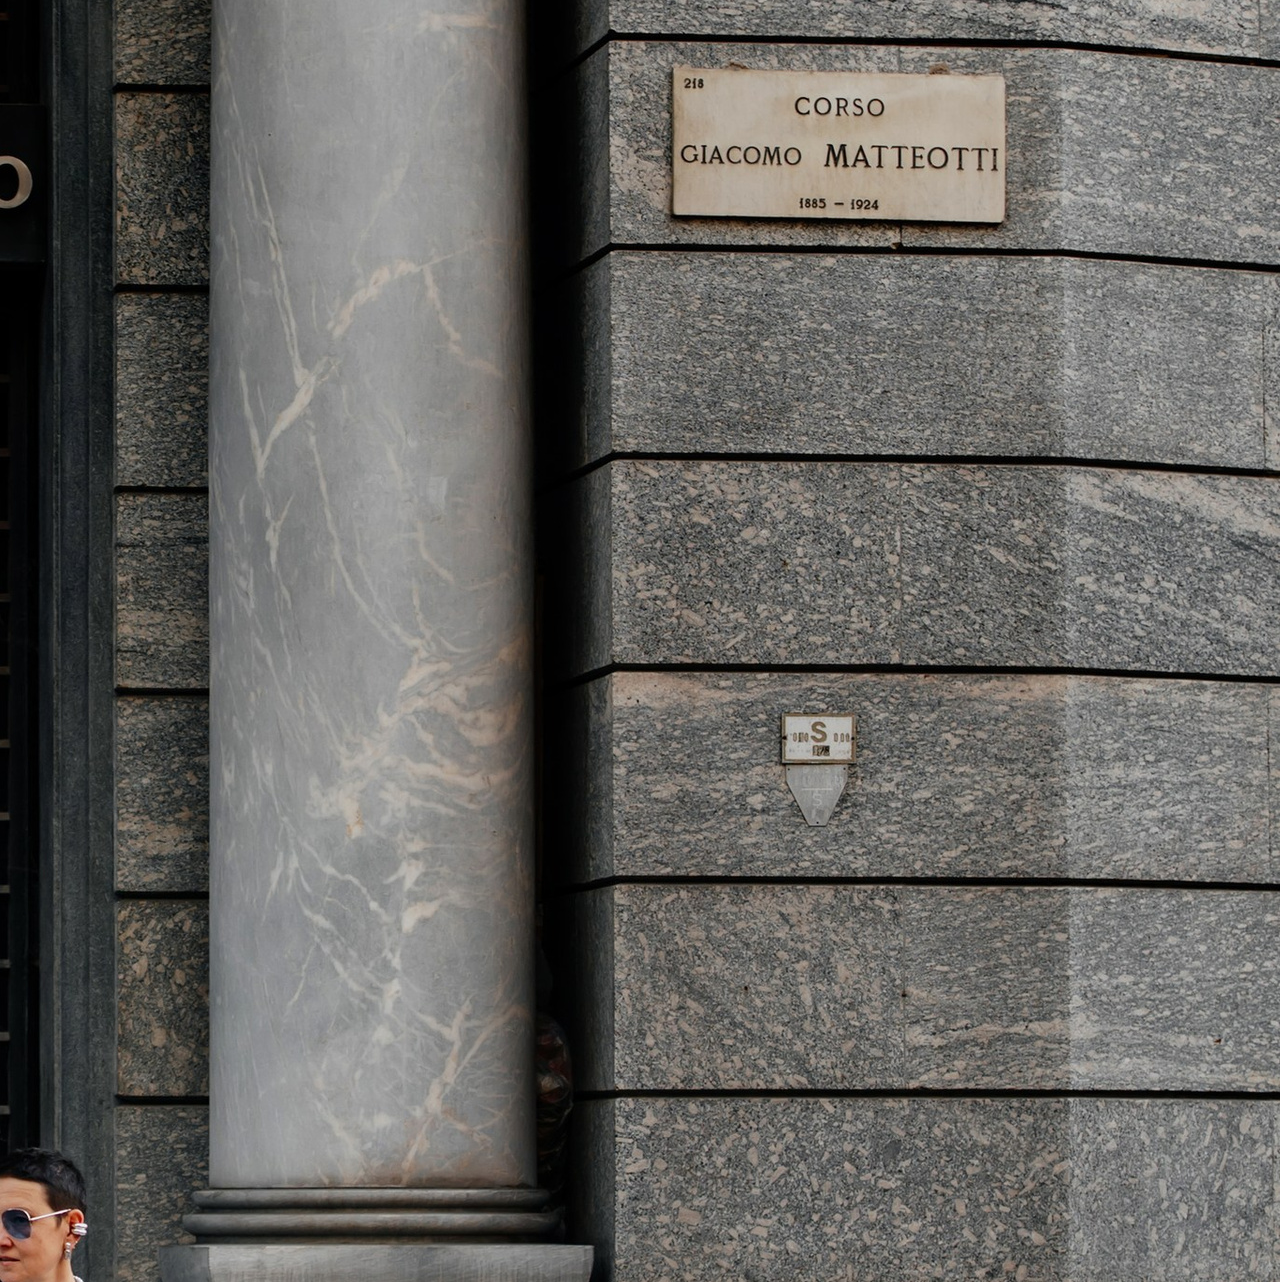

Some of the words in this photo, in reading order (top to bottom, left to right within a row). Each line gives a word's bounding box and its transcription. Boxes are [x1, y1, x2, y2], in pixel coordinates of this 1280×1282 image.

[683, 77, 705, 89] 218
[794, 96, 886, 117] CORSO
[680, 144, 802, 166] GIACOMO
[823, 143, 1000, 172] MATTEOTTI
[798, 197, 827, 209] 1885
[850, 198, 880, 211] 1924
[810, 721, 827, 743] S
